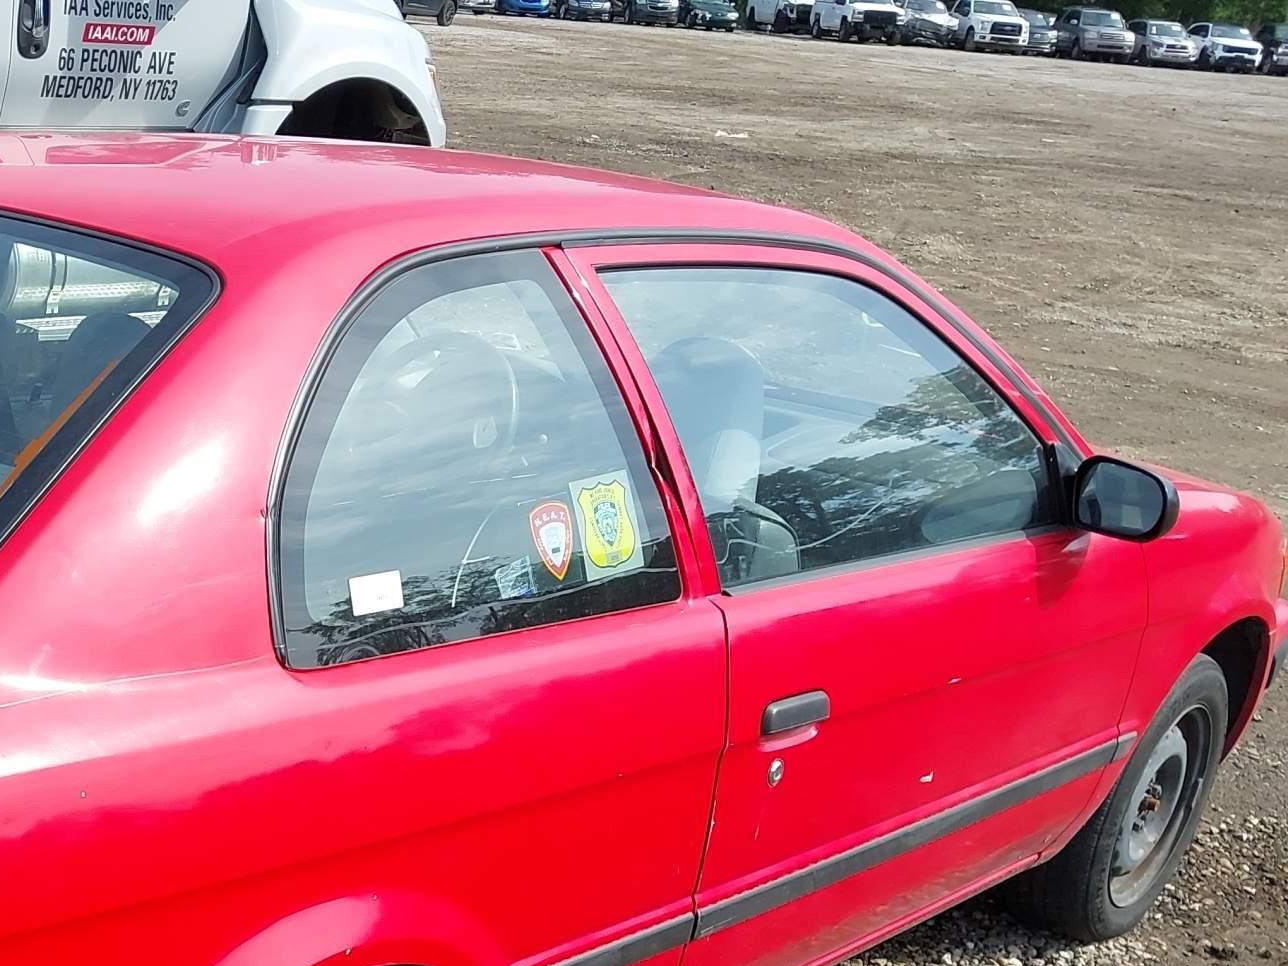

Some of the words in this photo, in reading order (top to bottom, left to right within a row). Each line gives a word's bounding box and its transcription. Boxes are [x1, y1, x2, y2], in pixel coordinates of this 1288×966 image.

[63, 0, 89, 16] IAA
[93, 0, 152, 23] Services,
[155, 0, 176, 21] Inc.
[87, 25, 150, 42] IAAI.COM
[58, 48, 75, 71] 66
[80, 48, 143, 74] PECONIC
[146, 51, 177, 74] AVE
[40, 75, 114, 101] MEDFORD,
[119, 78, 142, 100] NY
[144, 79, 178, 101] 11763
